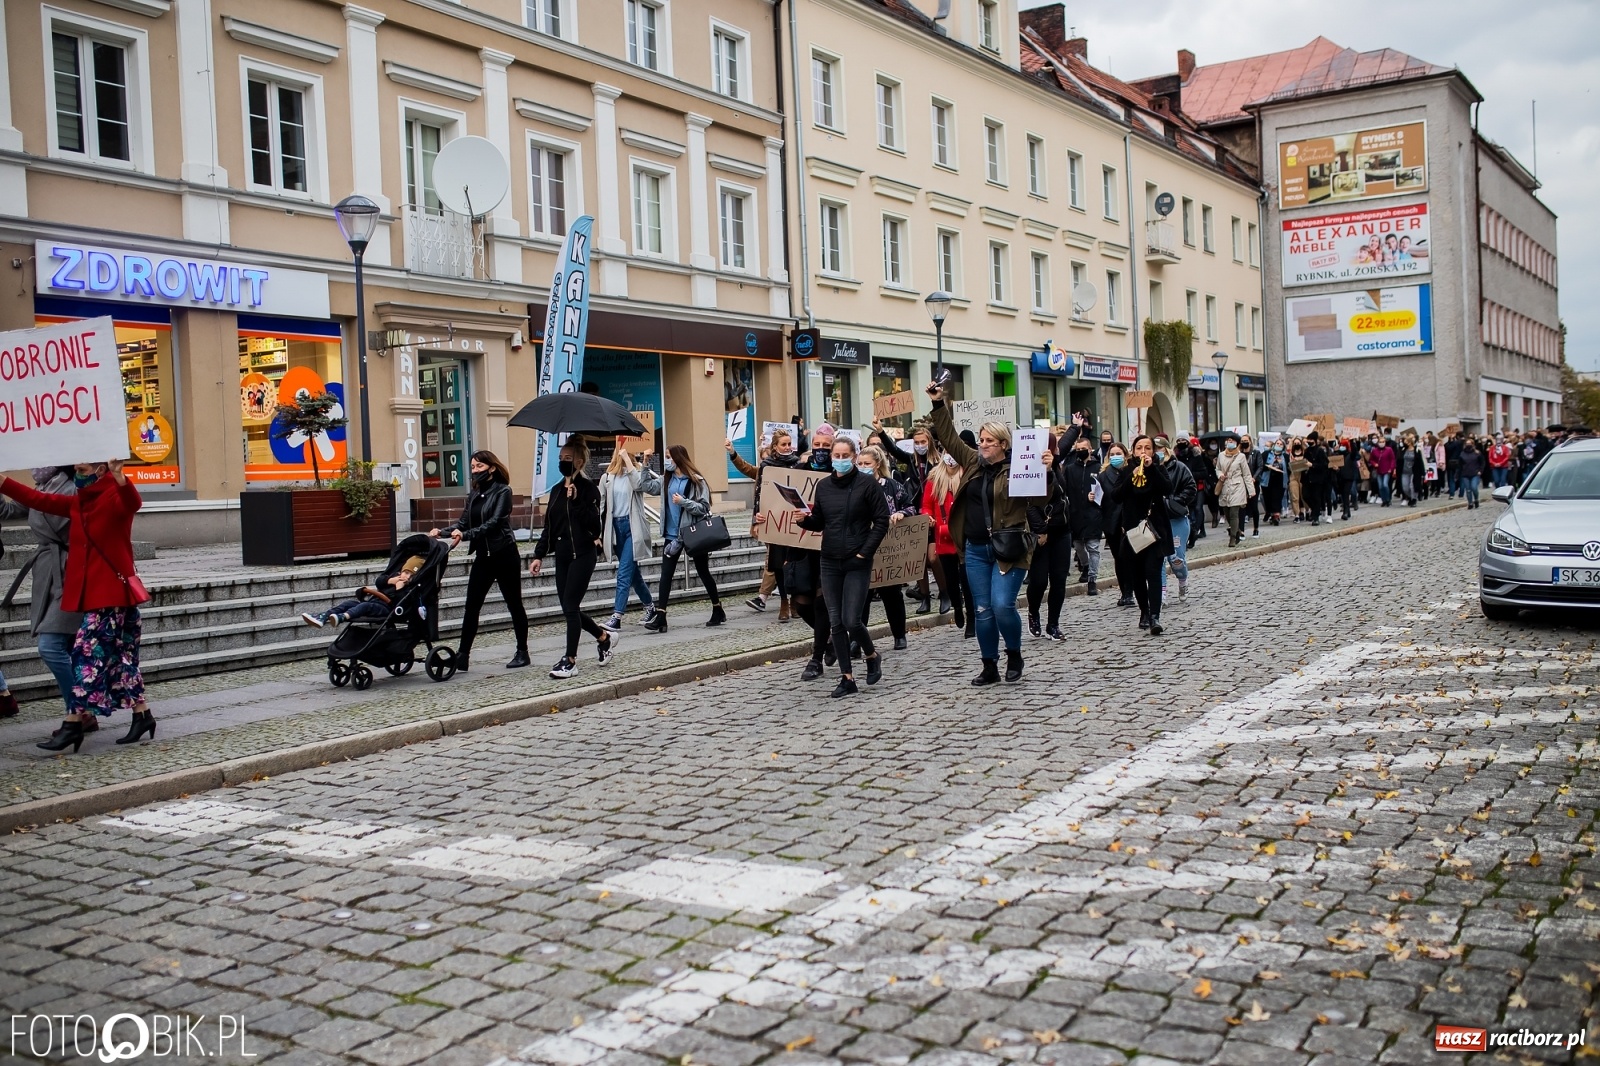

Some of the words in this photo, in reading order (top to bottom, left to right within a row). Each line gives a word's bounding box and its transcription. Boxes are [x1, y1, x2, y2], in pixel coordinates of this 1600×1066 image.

[1361, 132, 1395, 144] RYNEK
[1351, 209, 1391, 221] najlepszych
[1290, 217, 1421, 243] ALEXANDER
[1290, 241, 1335, 254] MEBLE
[51, 247, 269, 306] ZDROWIT
[1296, 271, 1338, 281] RYBNIK,
[1341, 269, 1352, 277] ul.
[1355, 264, 1399, 276] ŻORSKA
[1402, 262, 1417, 271] 192
[1357, 340, 1415, 351] castorama
[0, 332, 100, 381] OBRONIE
[1084, 363, 1111, 376] MATERACE
[636, 401, 653, 410] min
[137, 471, 160, 480] Nowa
[162, 471, 175, 479] 3-5
[1562, 570, 1579, 582] SK
